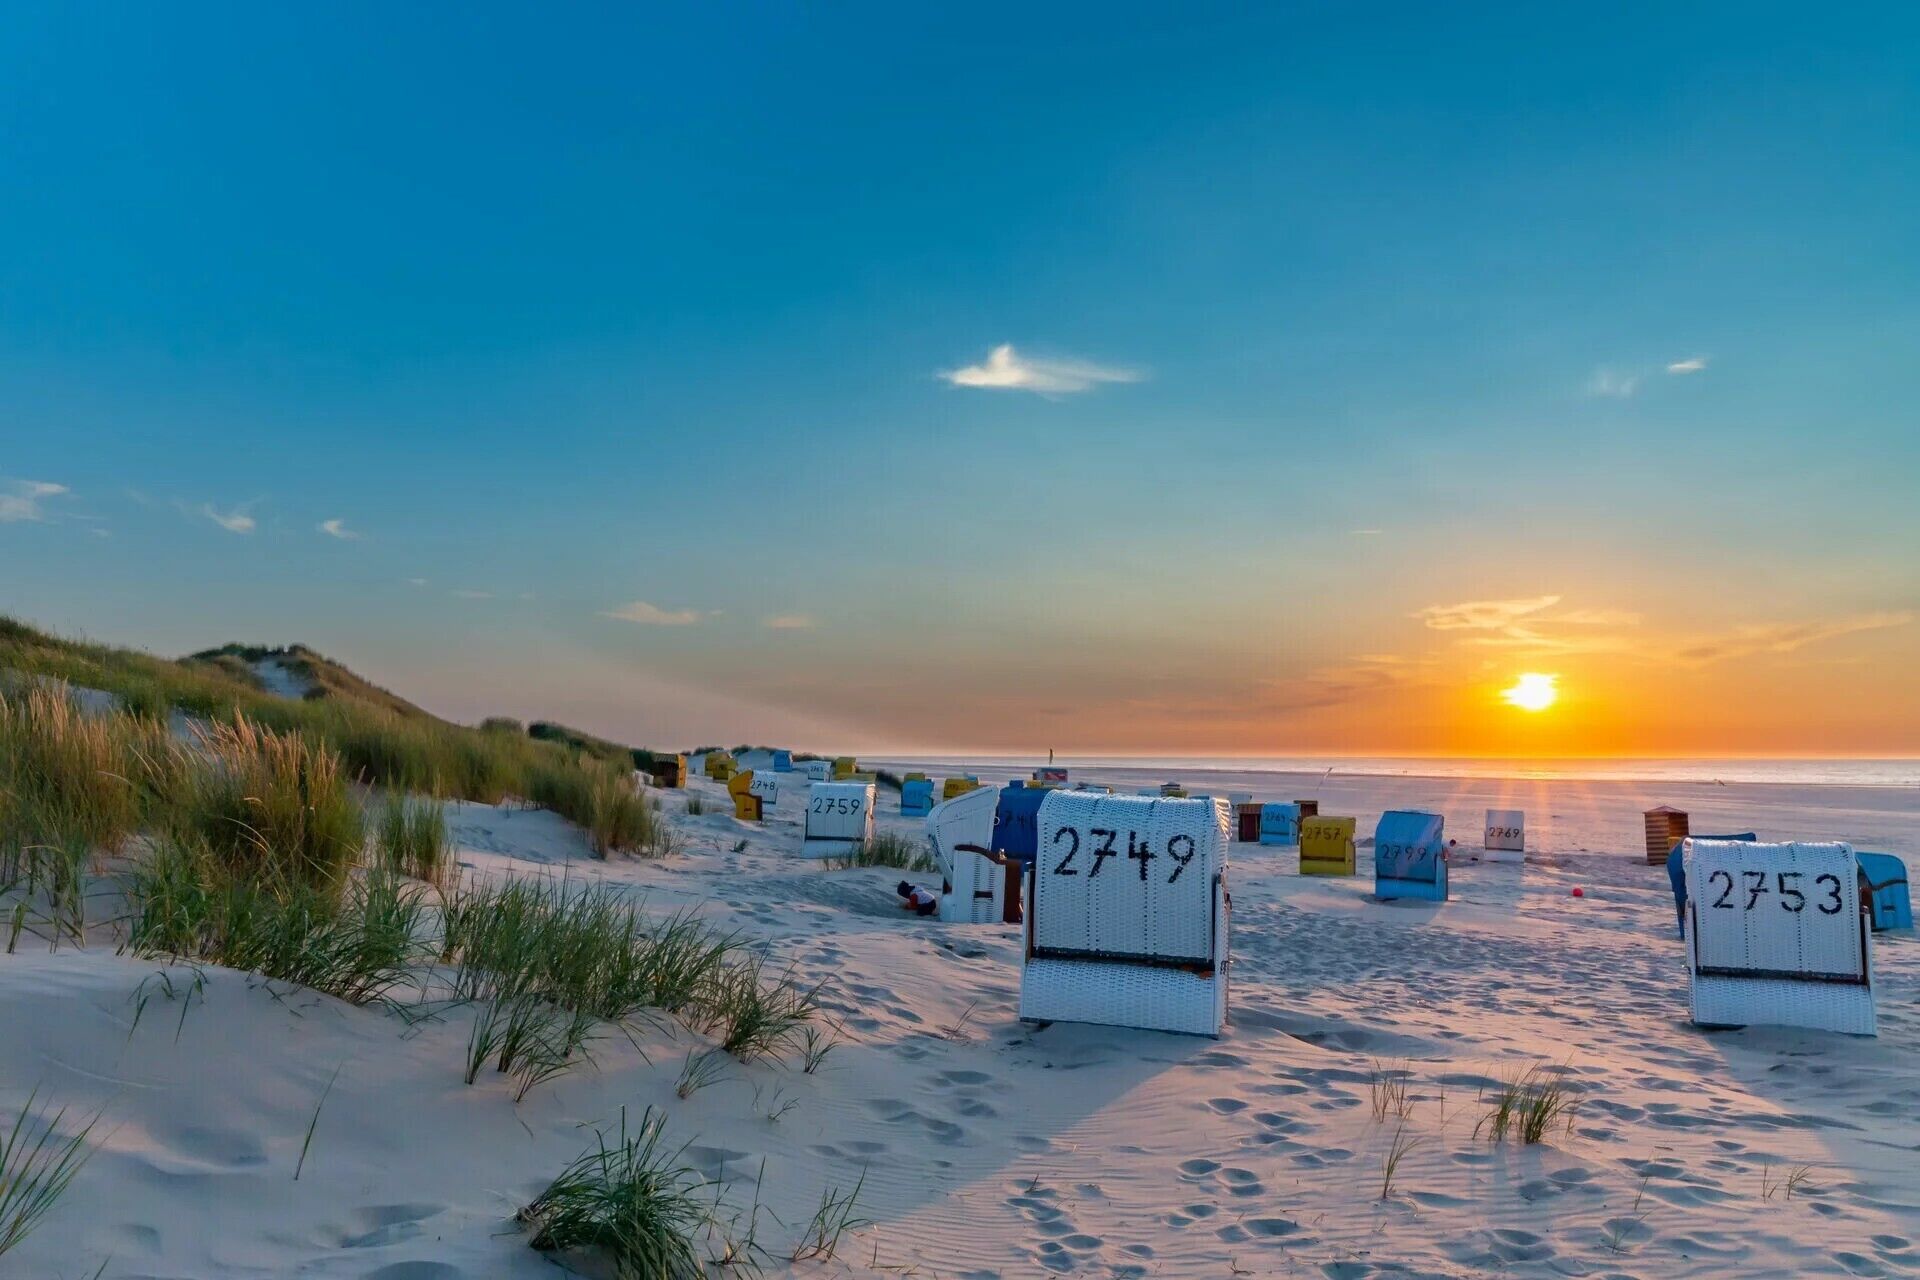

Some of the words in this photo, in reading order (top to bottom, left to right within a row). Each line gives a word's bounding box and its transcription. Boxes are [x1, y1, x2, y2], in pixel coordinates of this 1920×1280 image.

[750, 780, 776, 791] 2748
[813, 797, 860, 816] 2759
[1305, 826, 1341, 841] 2757
[1489, 826, 1520, 839] 2769
[1053, 827, 1195, 884] 2749
[1708, 870, 1842, 915] 2753
